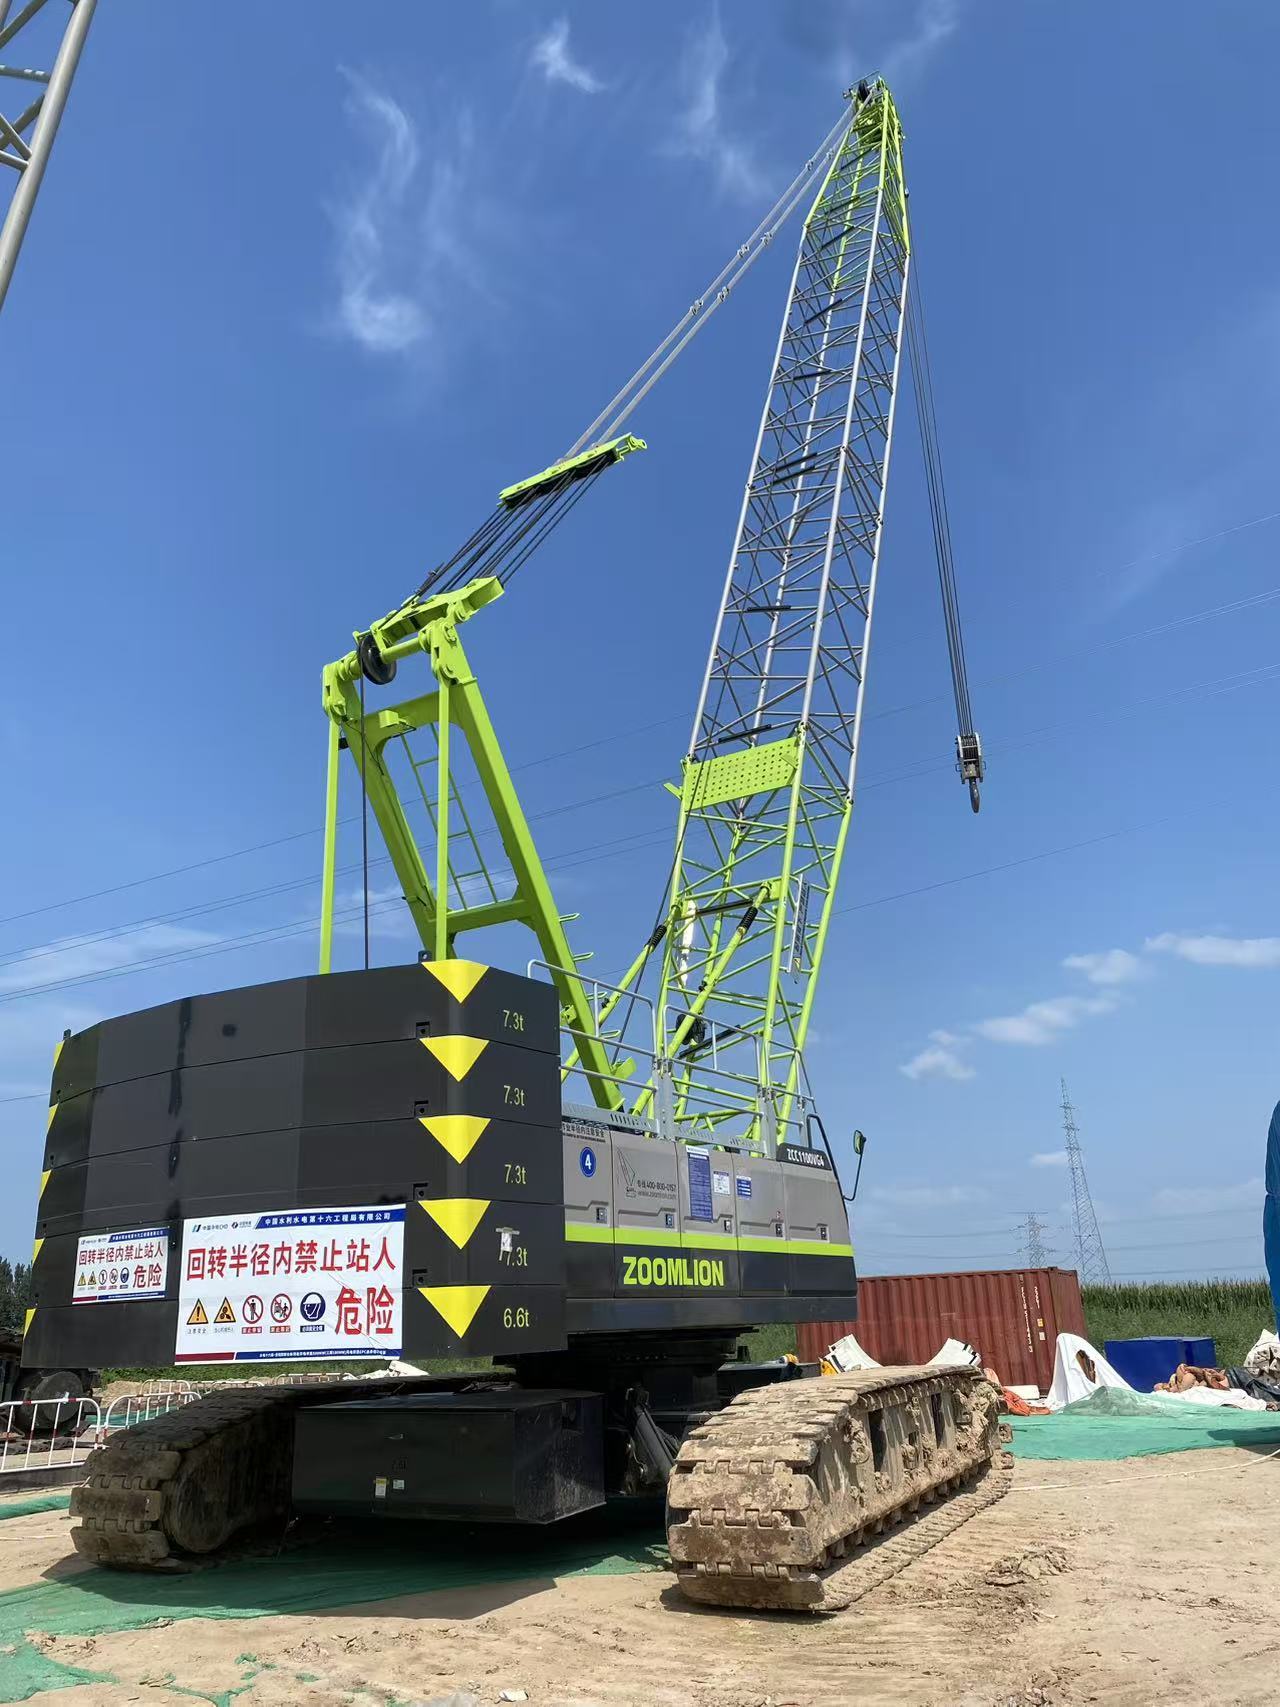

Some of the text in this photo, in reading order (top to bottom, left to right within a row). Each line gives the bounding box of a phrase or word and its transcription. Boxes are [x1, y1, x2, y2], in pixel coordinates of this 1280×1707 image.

[503, 1009, 524, 1031] 7.3t
[503, 1085, 525, 1106] 7.3t
[584, 1154, 592, 1170] 4
[504, 1164, 526, 1184] 7.3t
[264, 1212, 391, 1226] 中国水利水电第十六工程局有限公司
[79, 1241, 163, 1265] 回转半径内禁止站人
[187, 1236, 396, 1281] 回转半径内禁止站人
[132, 1263, 162, 1288] 危险
[623, 1256, 724, 1286] ZOOMLION
[334, 1284, 395, 1336] 危险
[503, 1307, 530, 1329] 6.6t
